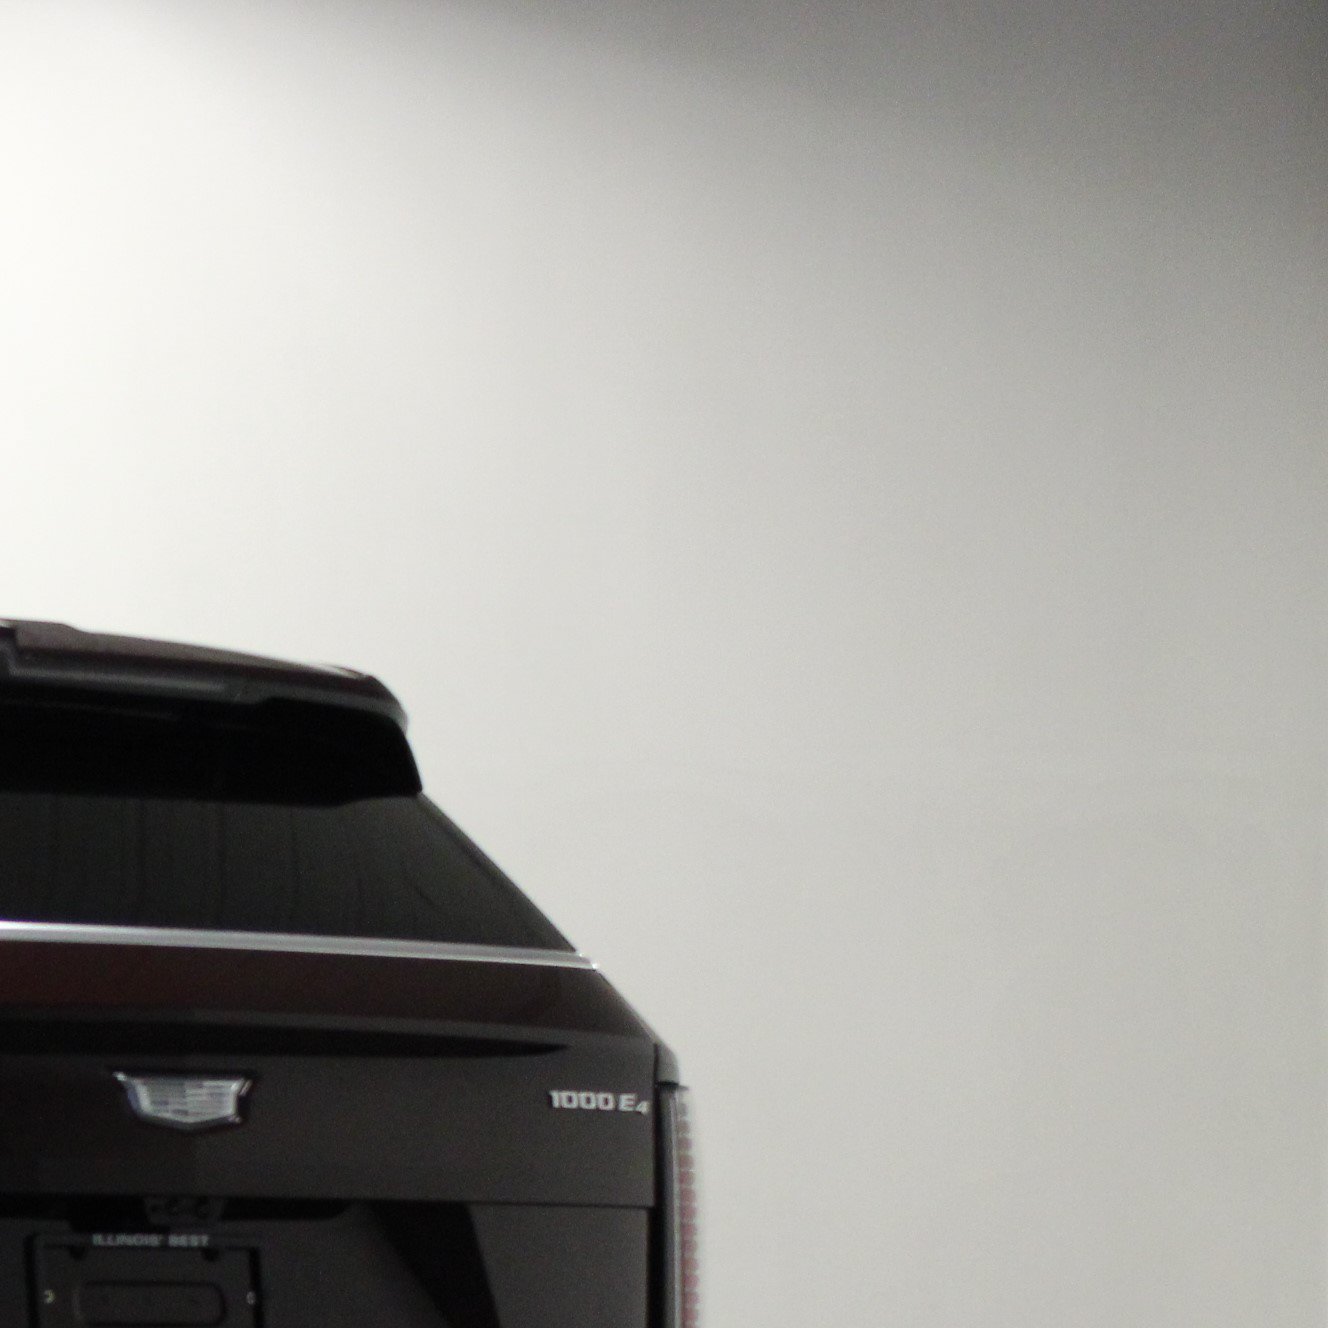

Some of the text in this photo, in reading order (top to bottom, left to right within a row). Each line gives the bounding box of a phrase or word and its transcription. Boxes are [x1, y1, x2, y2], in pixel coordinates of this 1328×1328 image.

[549, 1090, 650, 1115] 1000 E4
[167, 1233, 210, 1248] BEST
